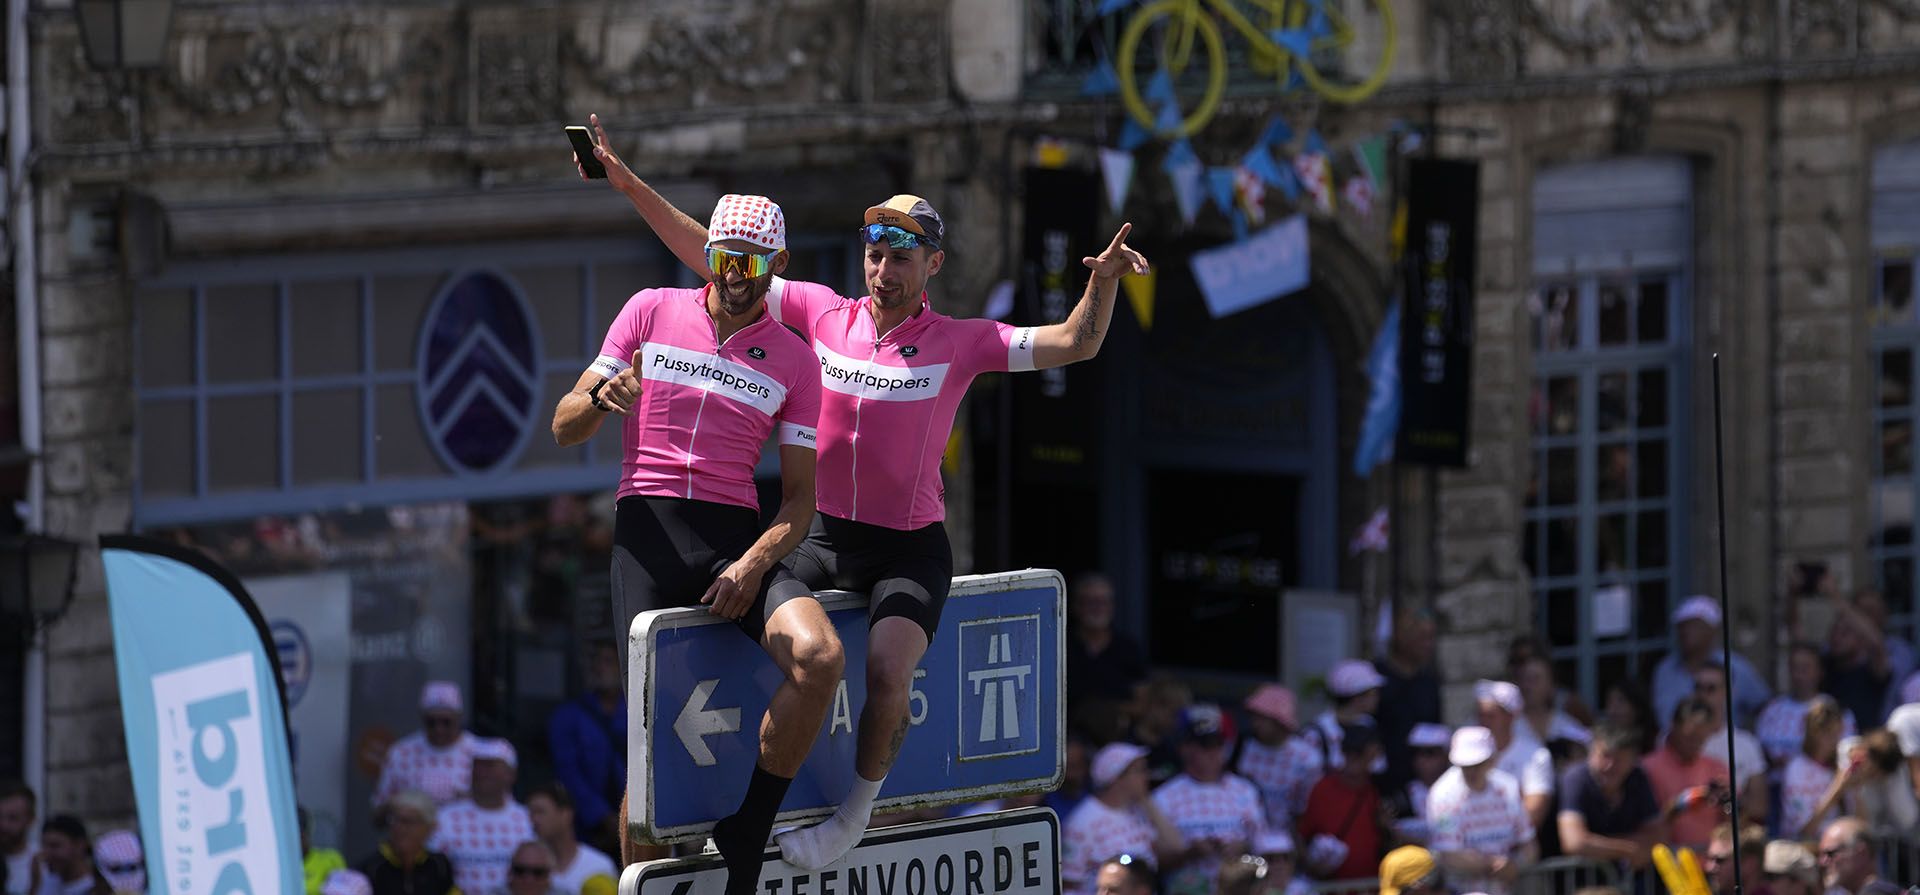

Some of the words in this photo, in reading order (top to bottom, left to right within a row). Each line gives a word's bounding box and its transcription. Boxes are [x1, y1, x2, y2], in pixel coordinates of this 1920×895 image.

[653, 354, 770, 399] Pussytrappers
[821, 356, 930, 392] Pussytrappers
[830, 679, 853, 736] A
